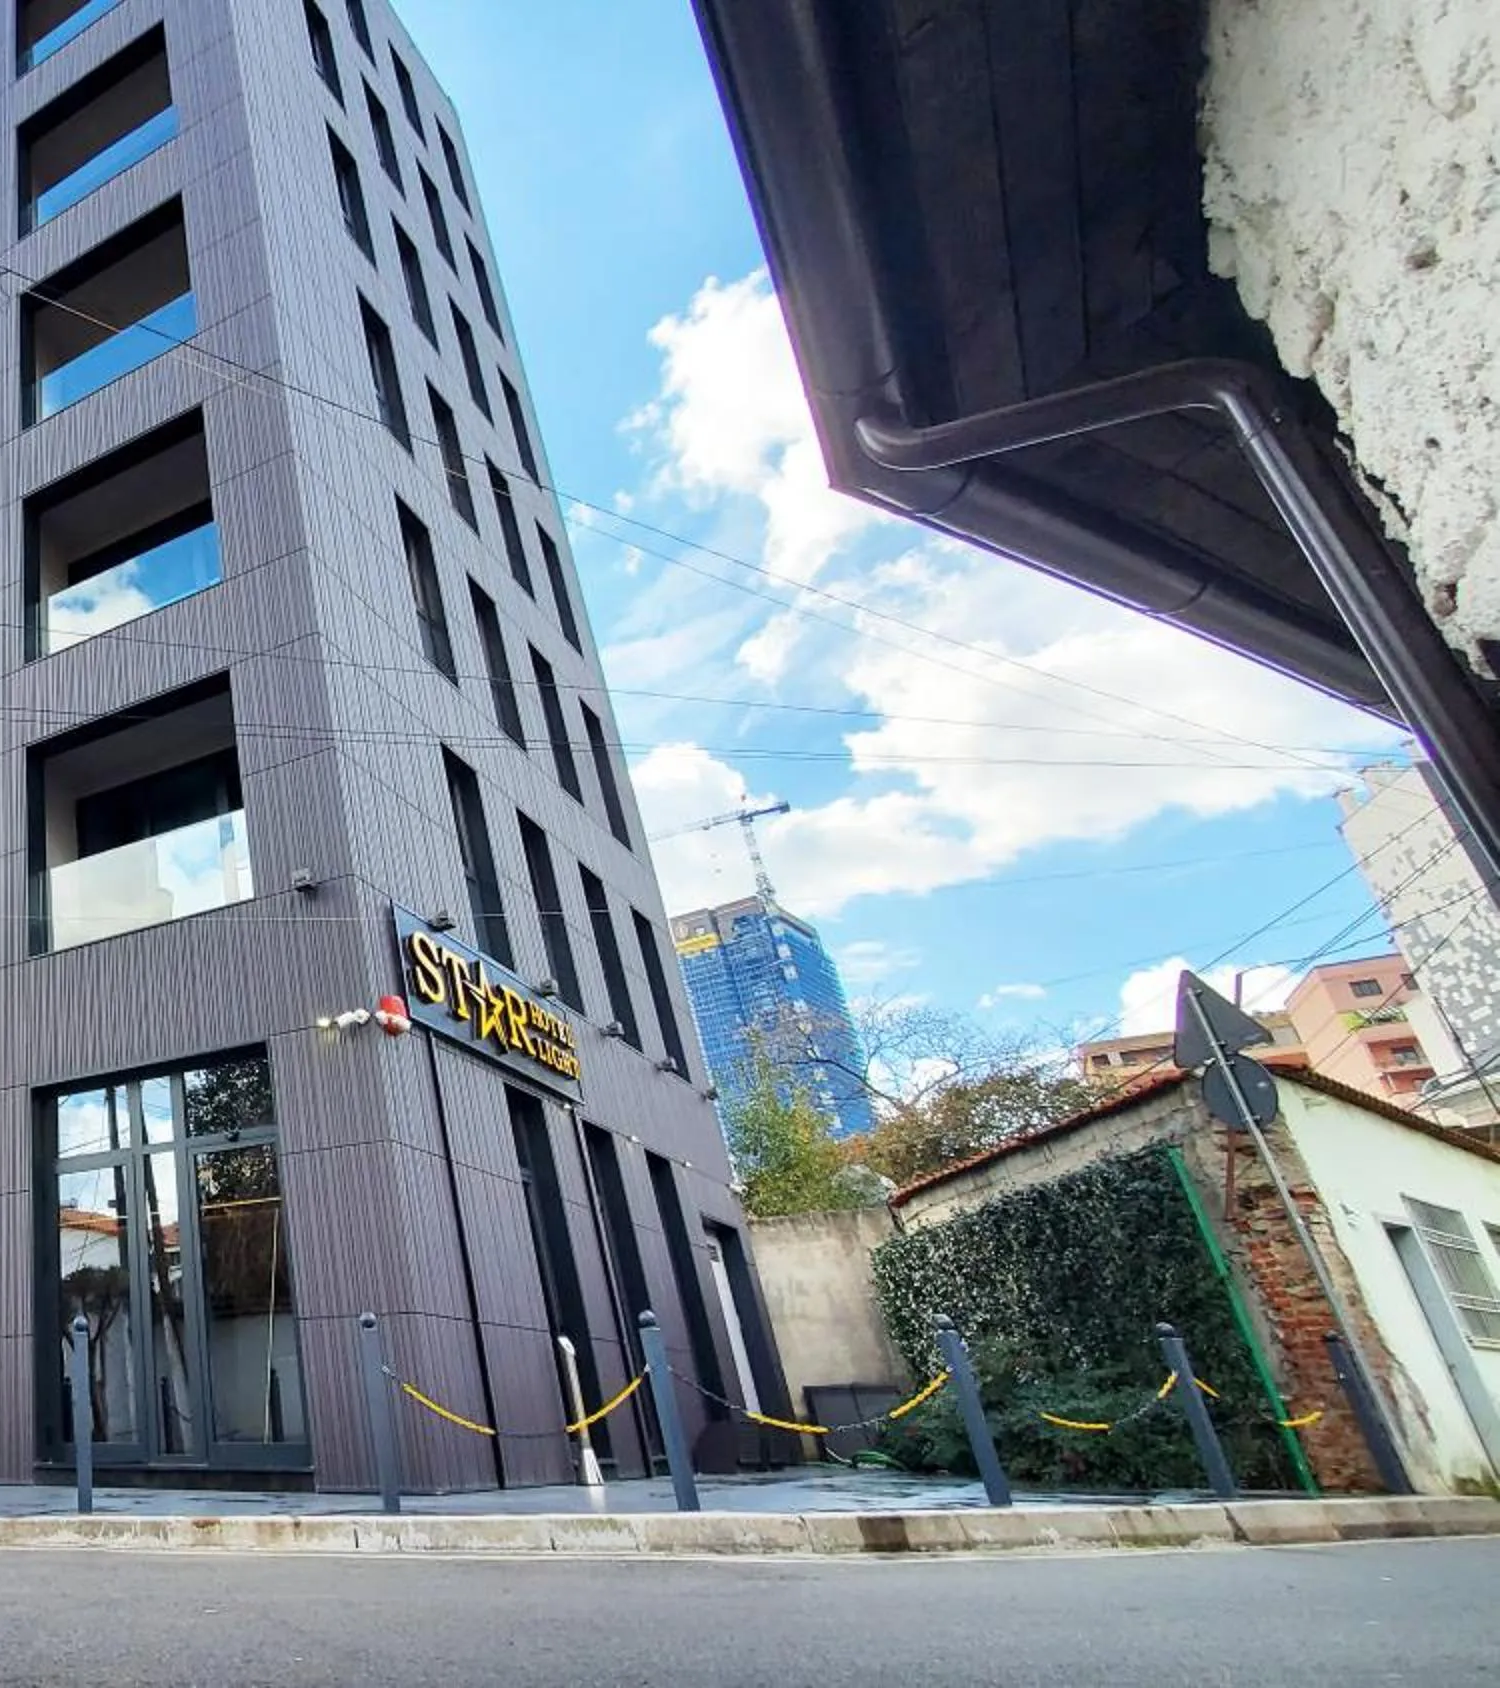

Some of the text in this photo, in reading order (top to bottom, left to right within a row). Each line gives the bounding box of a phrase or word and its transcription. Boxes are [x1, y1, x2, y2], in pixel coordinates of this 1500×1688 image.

[411, 930, 536, 1057] STAR
[530, 1001, 575, 1049] HOTEL
[537, 1037, 581, 1080] LIGHT
